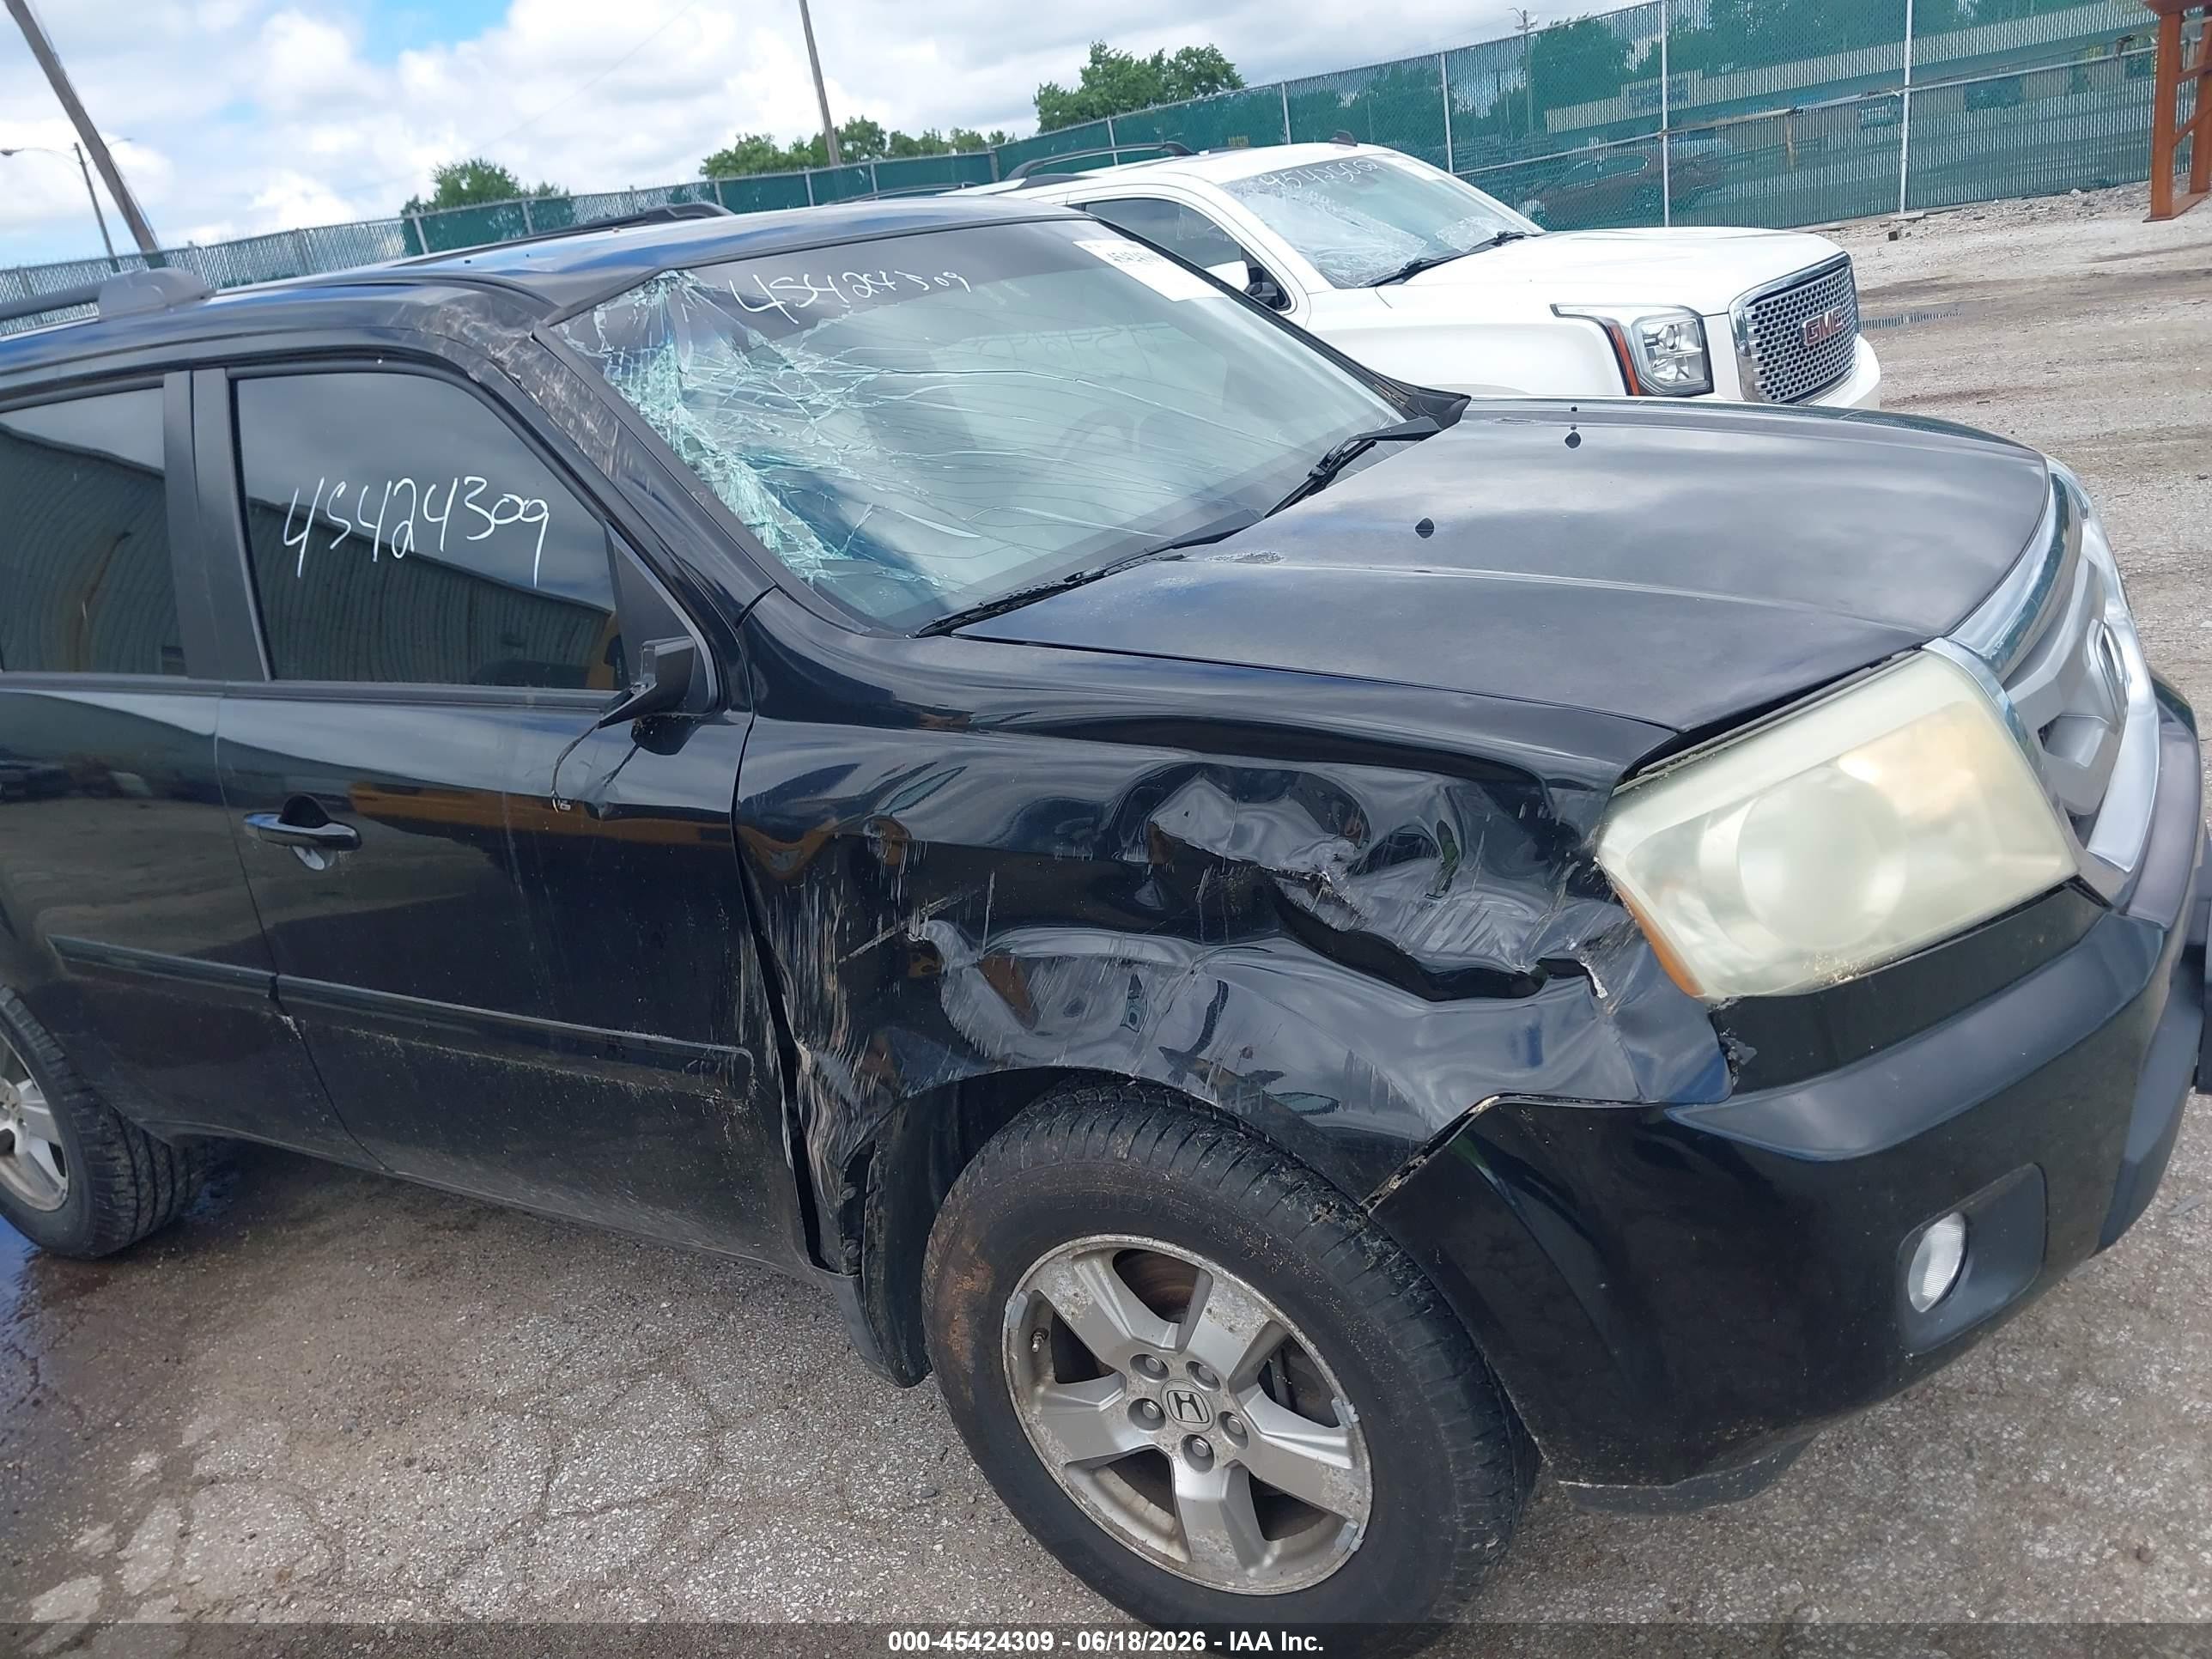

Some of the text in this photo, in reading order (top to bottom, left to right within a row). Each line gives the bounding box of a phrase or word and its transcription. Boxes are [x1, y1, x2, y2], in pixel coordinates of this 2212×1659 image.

[729, 270, 971, 325] 45424309
[1802, 306, 1844, 345] GMC
[283, 476, 550, 588] 45424309
